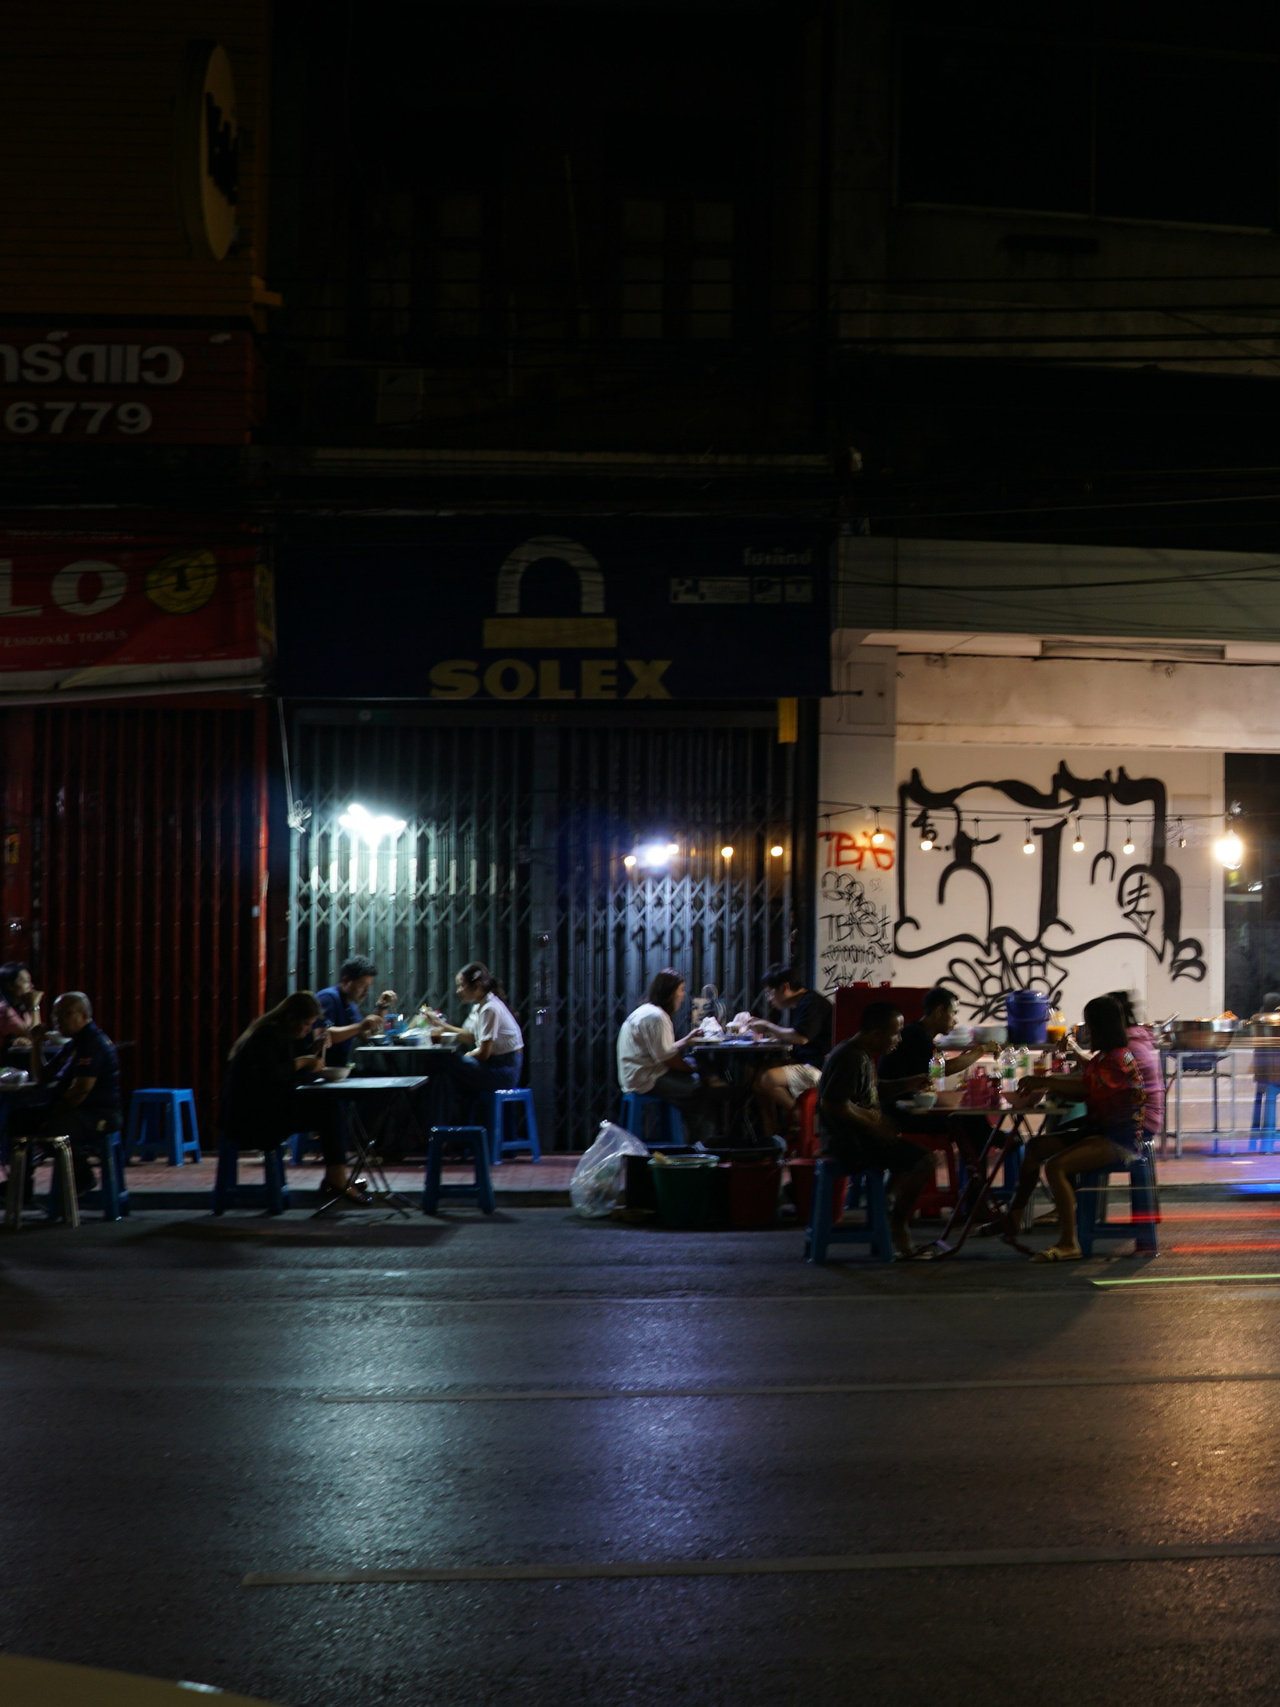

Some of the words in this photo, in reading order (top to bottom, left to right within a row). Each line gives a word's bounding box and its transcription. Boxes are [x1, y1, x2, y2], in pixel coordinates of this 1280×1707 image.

[3, 401, 154, 435] 6779
[78, 629, 129, 645] TOOLS
[428, 657, 674, 700] SOLEX
